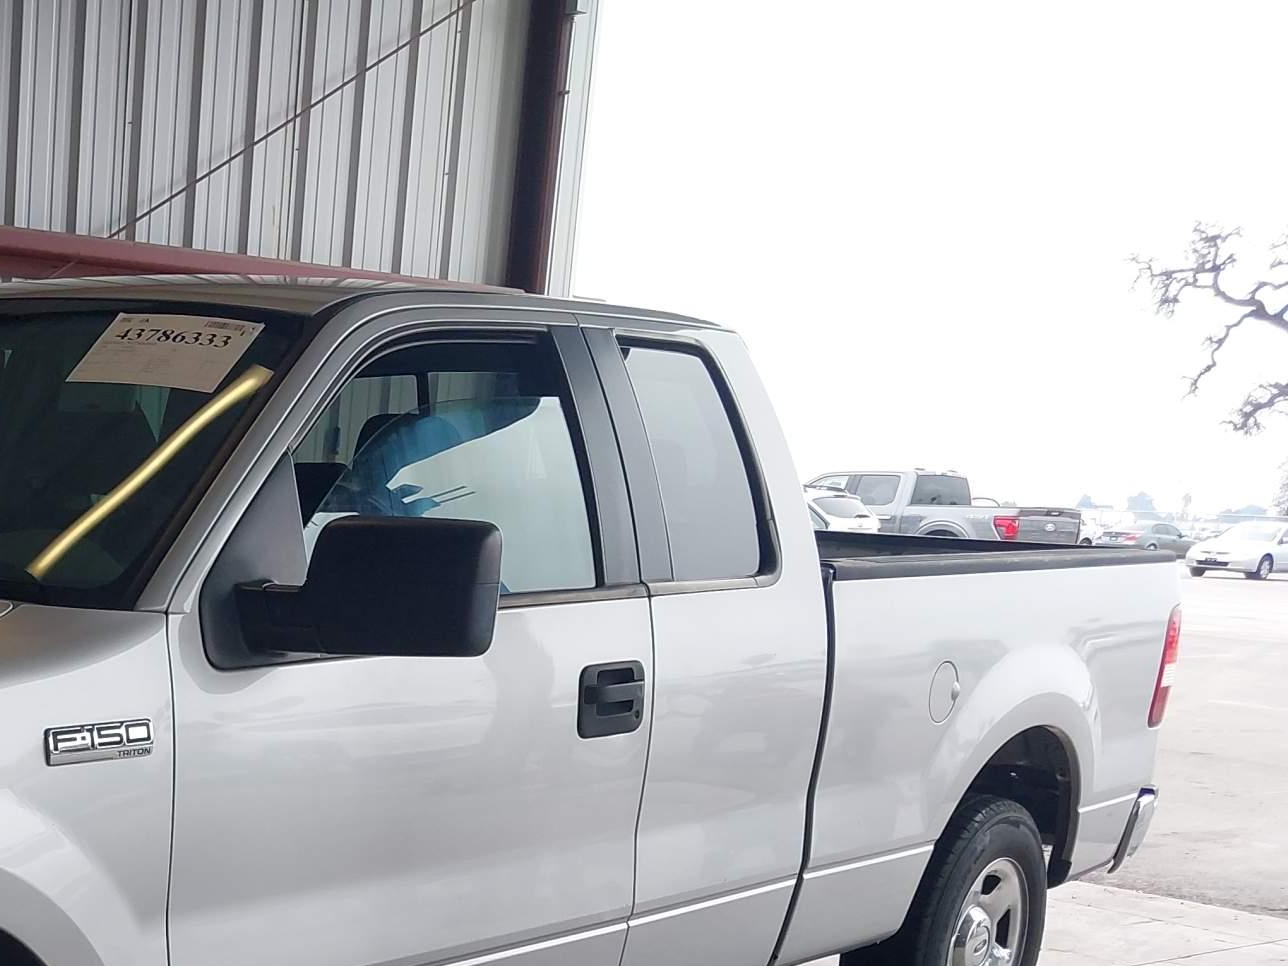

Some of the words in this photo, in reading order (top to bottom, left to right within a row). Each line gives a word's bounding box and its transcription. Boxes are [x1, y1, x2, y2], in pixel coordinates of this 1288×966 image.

[114, 327, 232, 348] 43786333
[50, 720, 154, 754] F-150
[117, 747, 152, 759] TRITON
